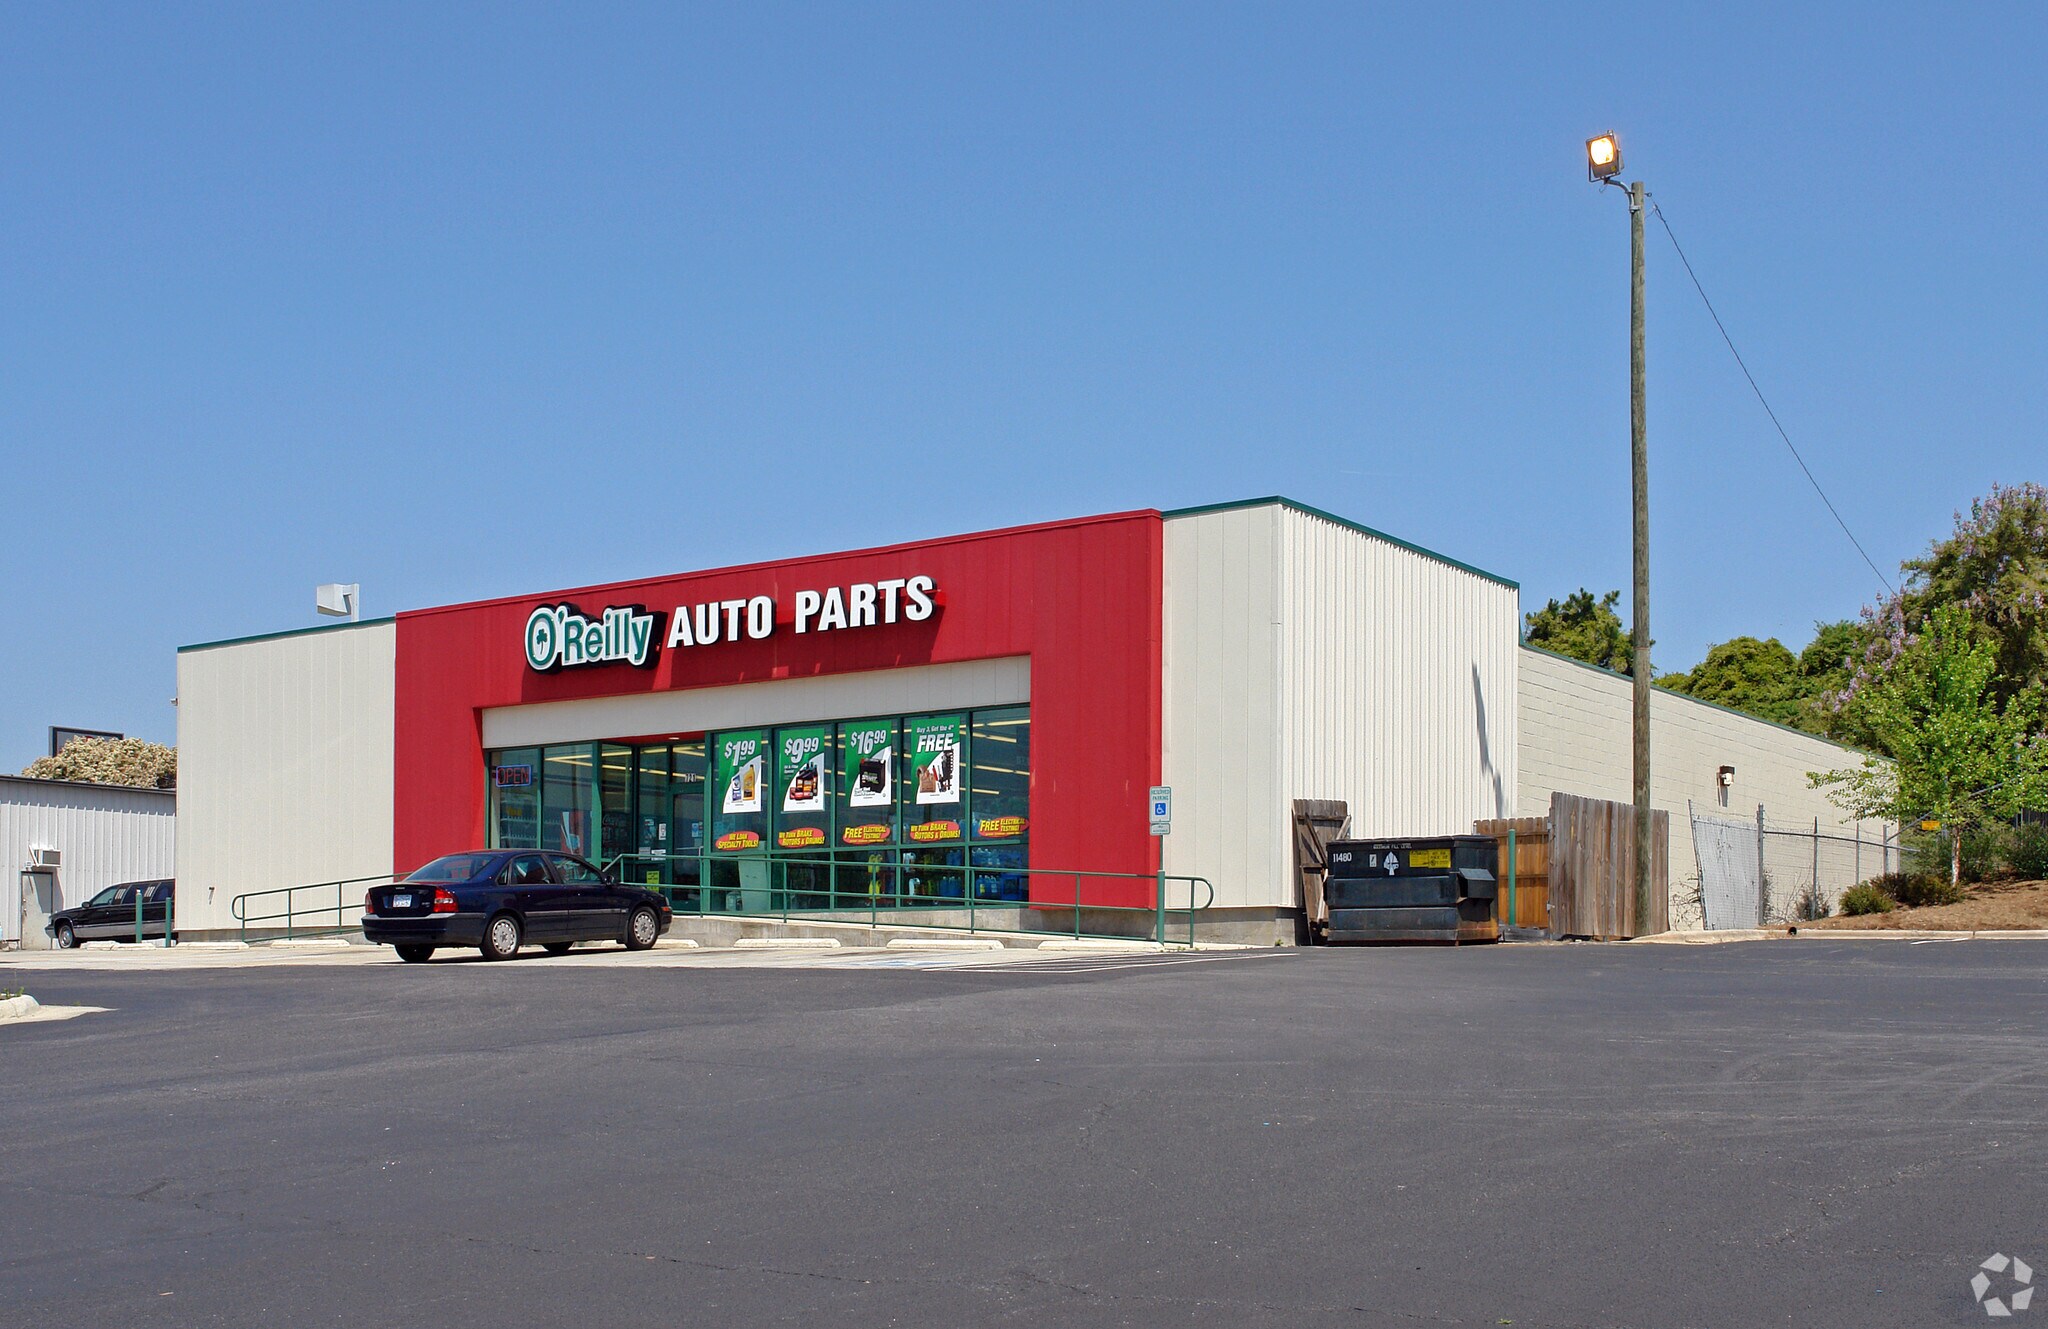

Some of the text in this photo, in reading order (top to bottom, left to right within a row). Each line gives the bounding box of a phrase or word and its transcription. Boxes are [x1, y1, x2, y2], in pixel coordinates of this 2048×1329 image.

[525, 575, 933, 670] O'Reilly AUTO PARTS
[916, 733, 953, 753] FREE
[498, 767, 529, 784] OPEN
[930, 823, 947, 831] BRAKE
[980, 820, 1000, 831] FREE
[797, 829, 812, 837] BRAKE
[844, 827, 862, 838] FREE
[914, 831, 934, 839] ROTORS
[718, 839, 759, 849] SPECIALTY TOOLS!
[782, 838, 801, 846] ROTORS
[1332, 852, 1352, 862] 11480
